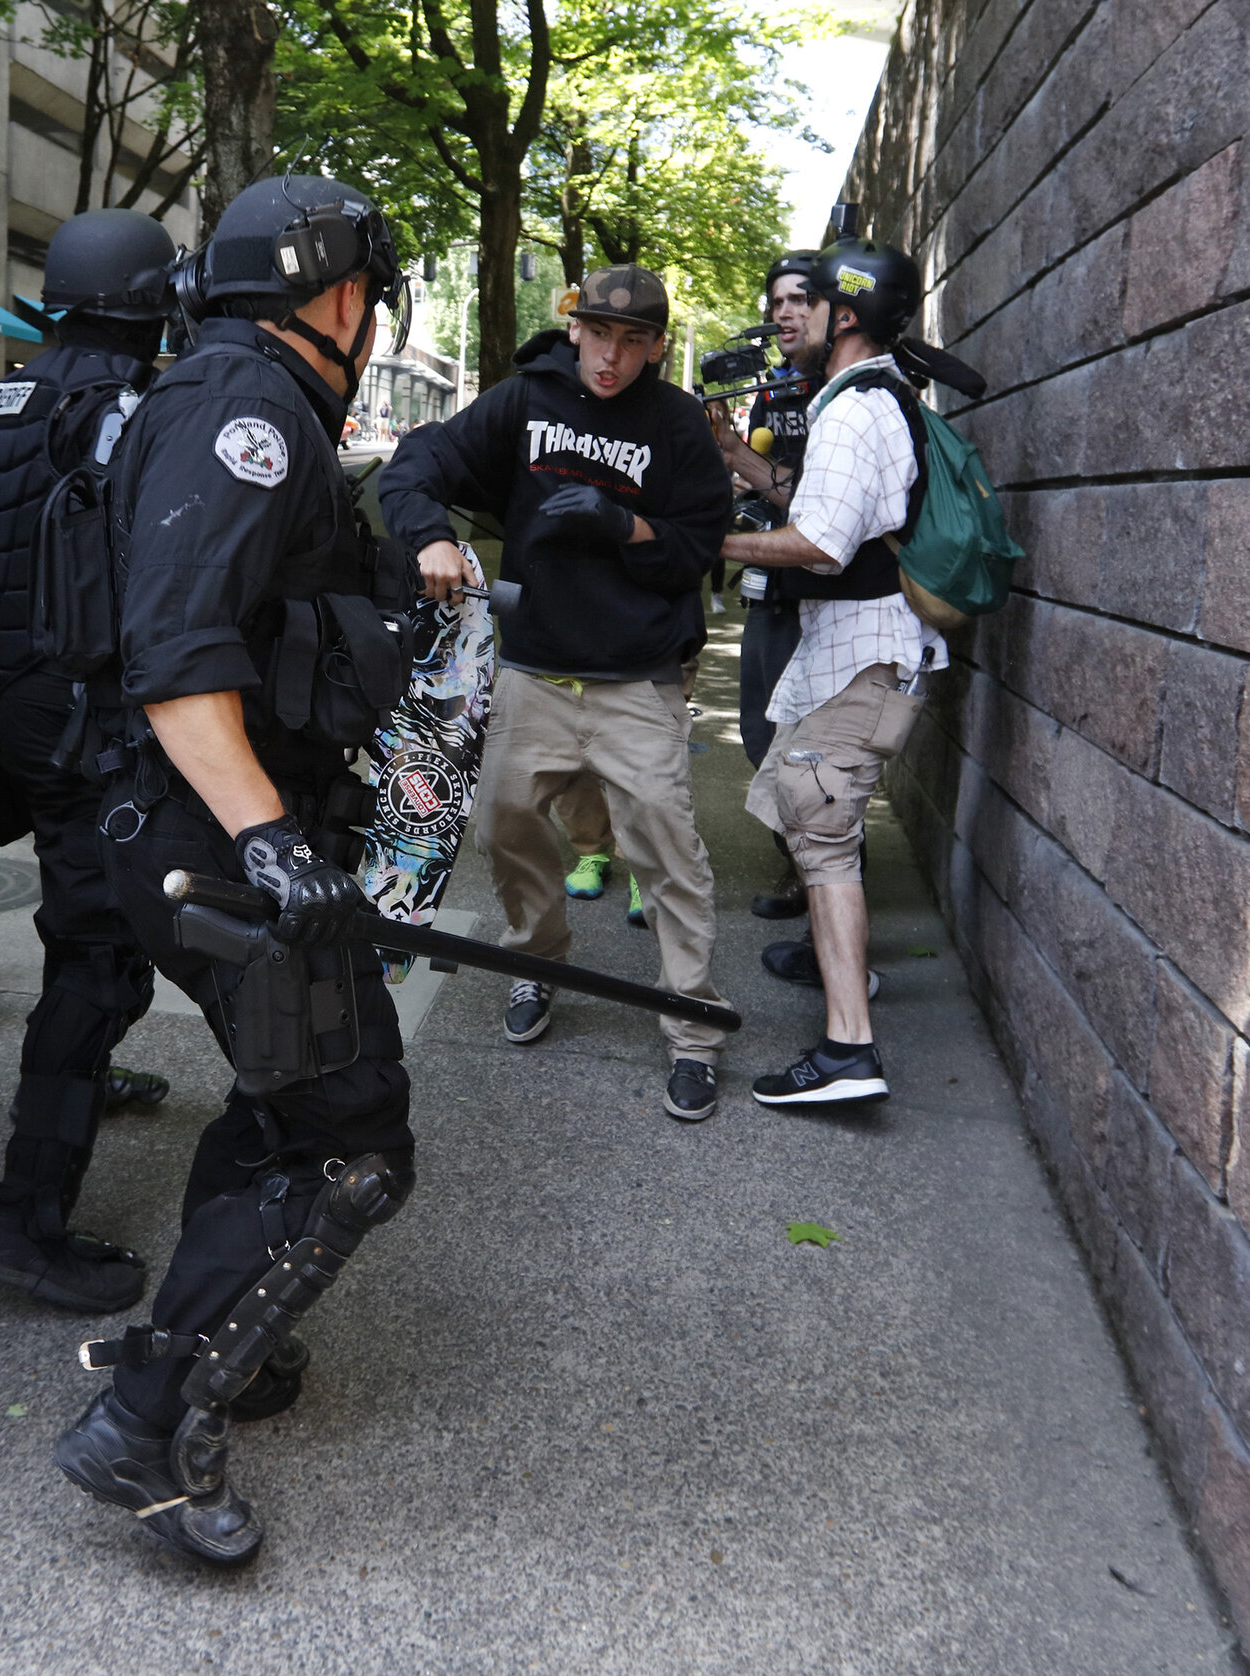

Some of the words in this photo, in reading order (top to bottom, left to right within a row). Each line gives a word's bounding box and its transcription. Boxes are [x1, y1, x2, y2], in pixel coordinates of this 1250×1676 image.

[840, 271, 873, 289] UNICORN
[841, 281, 859, 294] RIOT
[766, 411, 807, 436] PRES
[268, 427, 286, 458] Police
[527, 420, 652, 488] THRASHER
[530, 464, 584, 478] SKABAR
[379, 788, 400, 825] SINCE
[401, 780, 427, 814] CONVERSE
[405, 773, 462, 835] SKATEBOARDS
[409, 773, 439, 811] CONS
